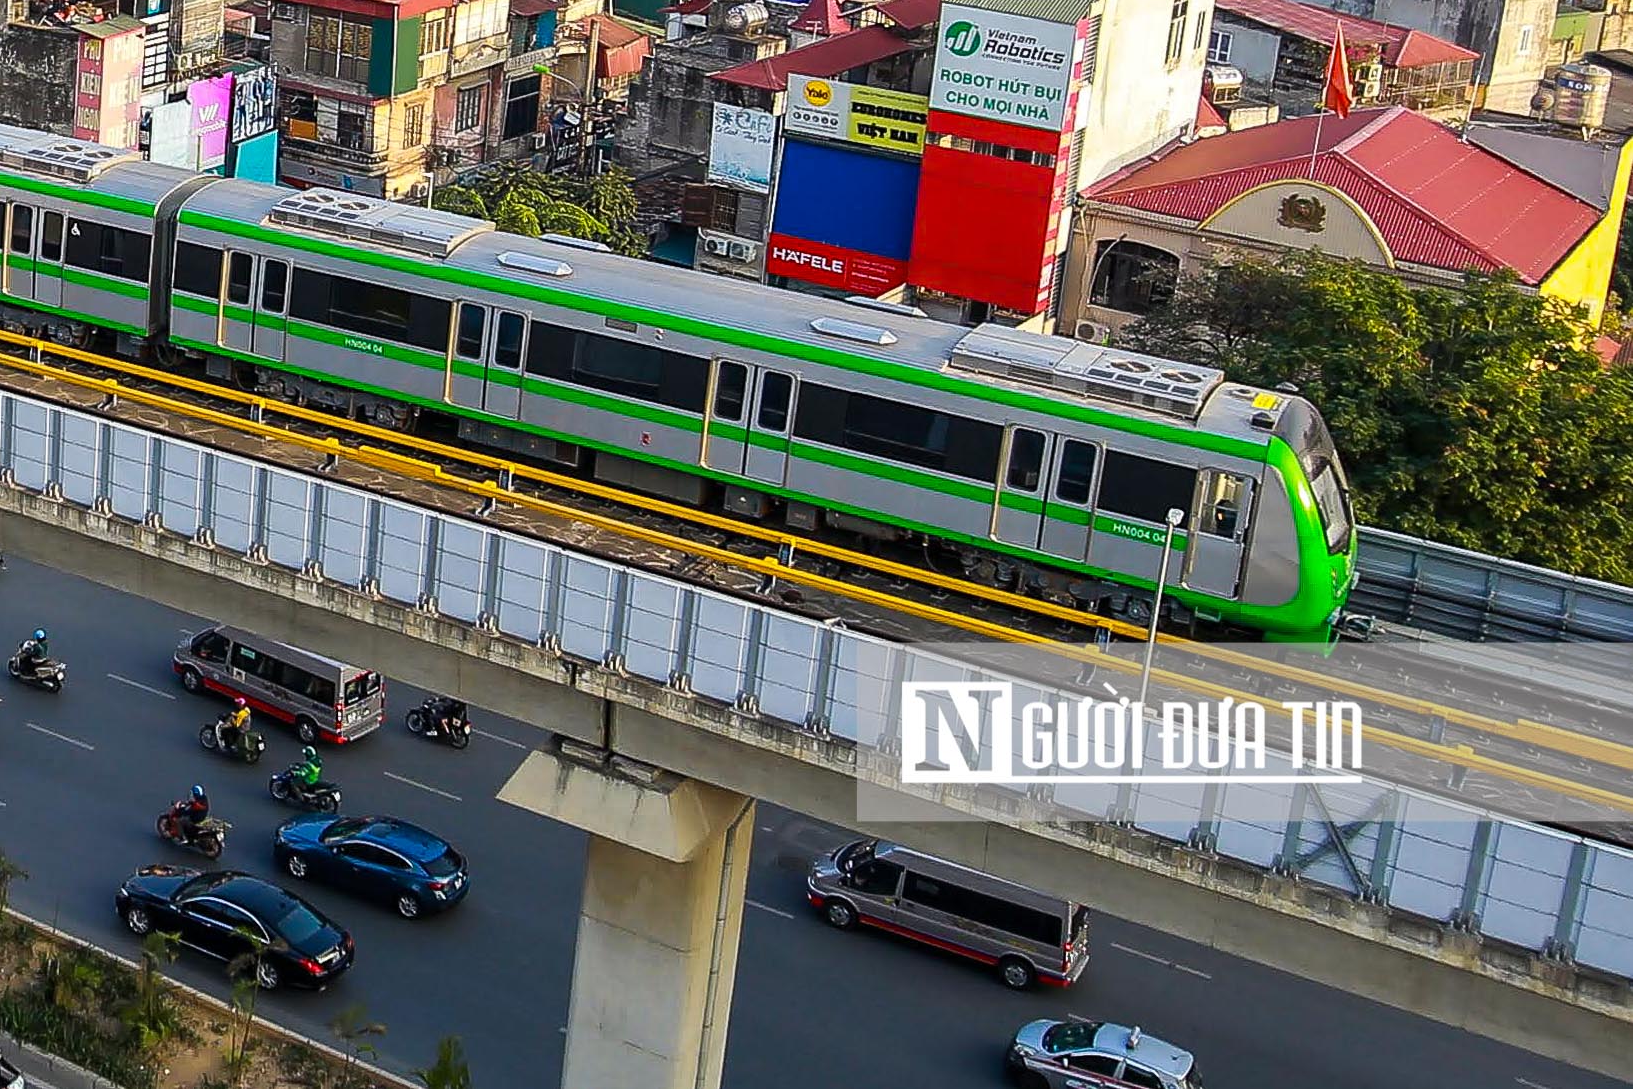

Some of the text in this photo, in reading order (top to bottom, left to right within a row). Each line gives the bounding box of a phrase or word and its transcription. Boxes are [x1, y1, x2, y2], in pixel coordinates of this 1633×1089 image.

[987, 29, 1037, 45] Vietnam
[983, 39, 1065, 65] Robotics
[806, 86, 829, 101] Yale
[940, 69, 1062, 102] ROBOT HÚT BỤI
[946, 91, 1049, 120] CHO MỌI NHÀ
[772, 247, 844, 274] HÄFELE
[1113, 523, 1151, 540] HN004
